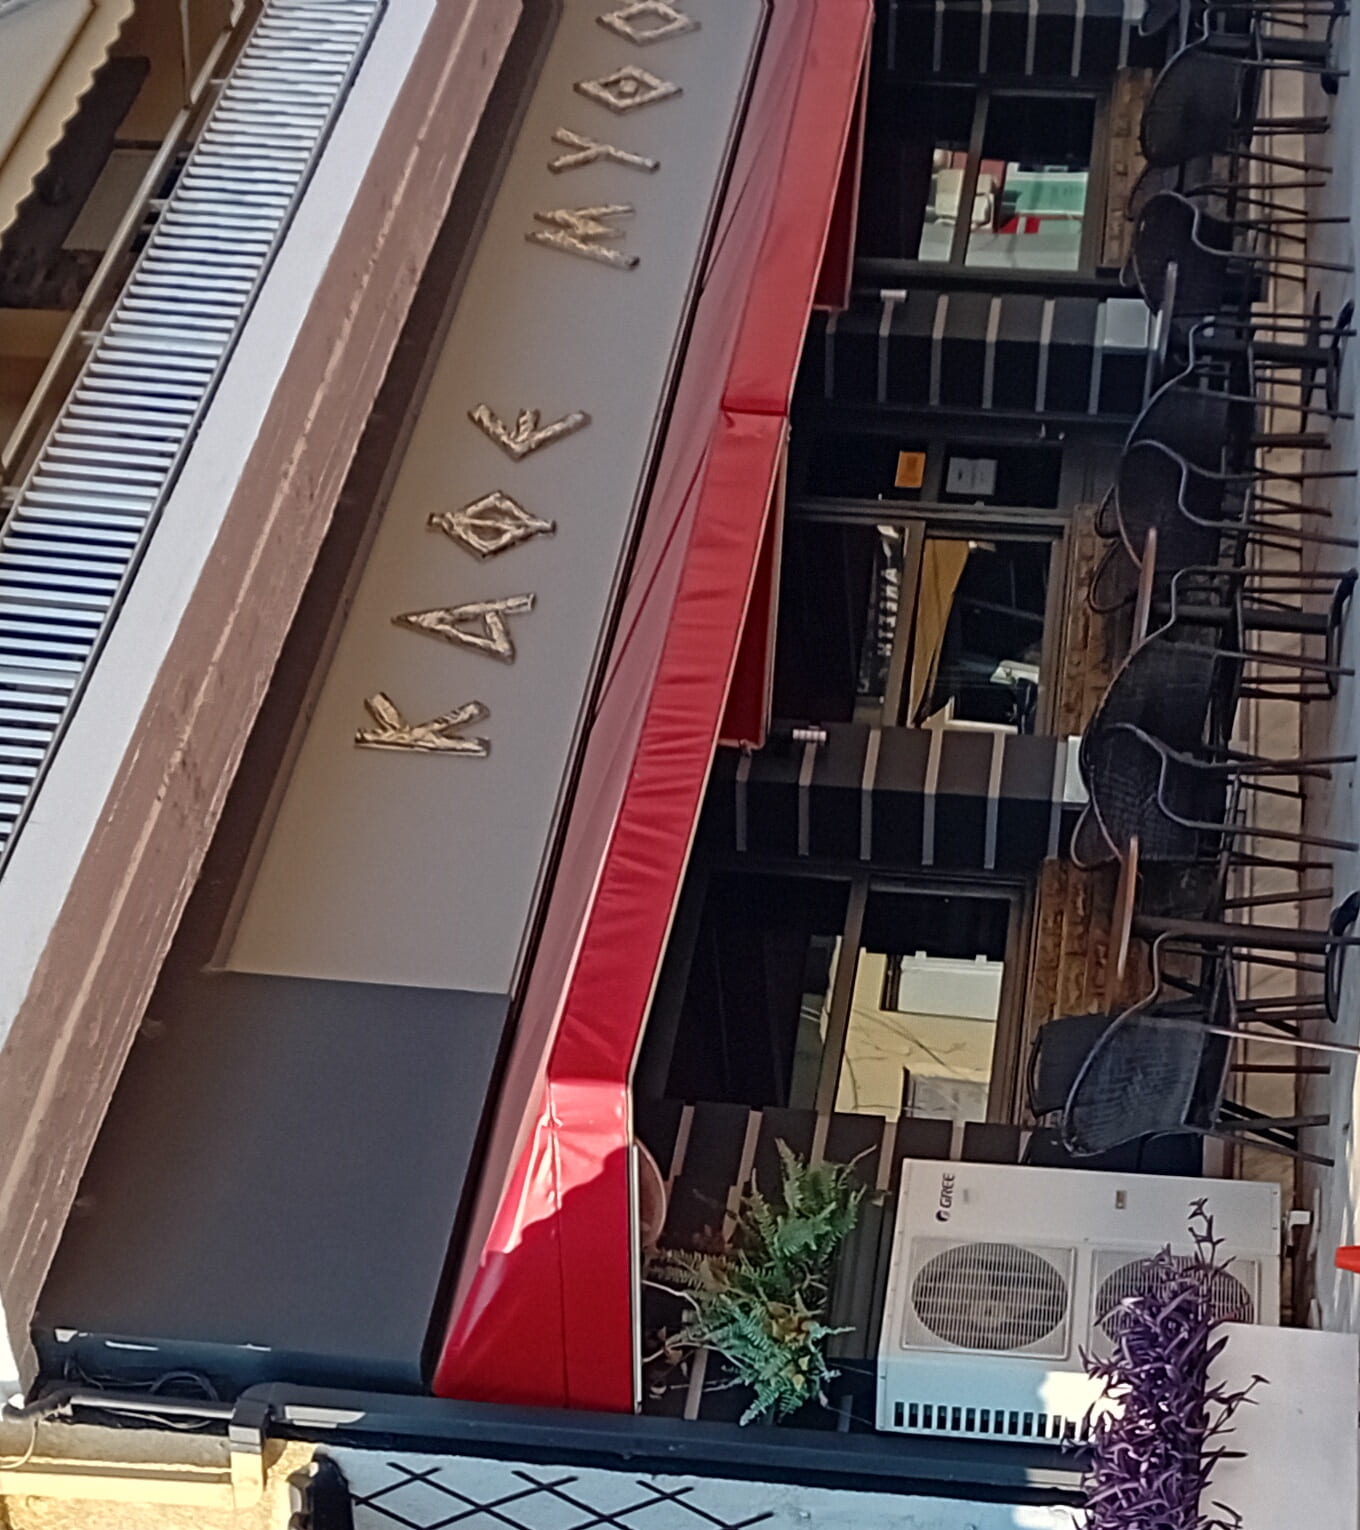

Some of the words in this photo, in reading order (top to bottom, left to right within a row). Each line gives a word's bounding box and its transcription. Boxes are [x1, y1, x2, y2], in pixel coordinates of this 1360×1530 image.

[353, 401, 592, 758] ΚΑΦΕ
[523, 0, 701, 271] ΜΥΘΟ
[940, 1173, 955, 1208] GREE
